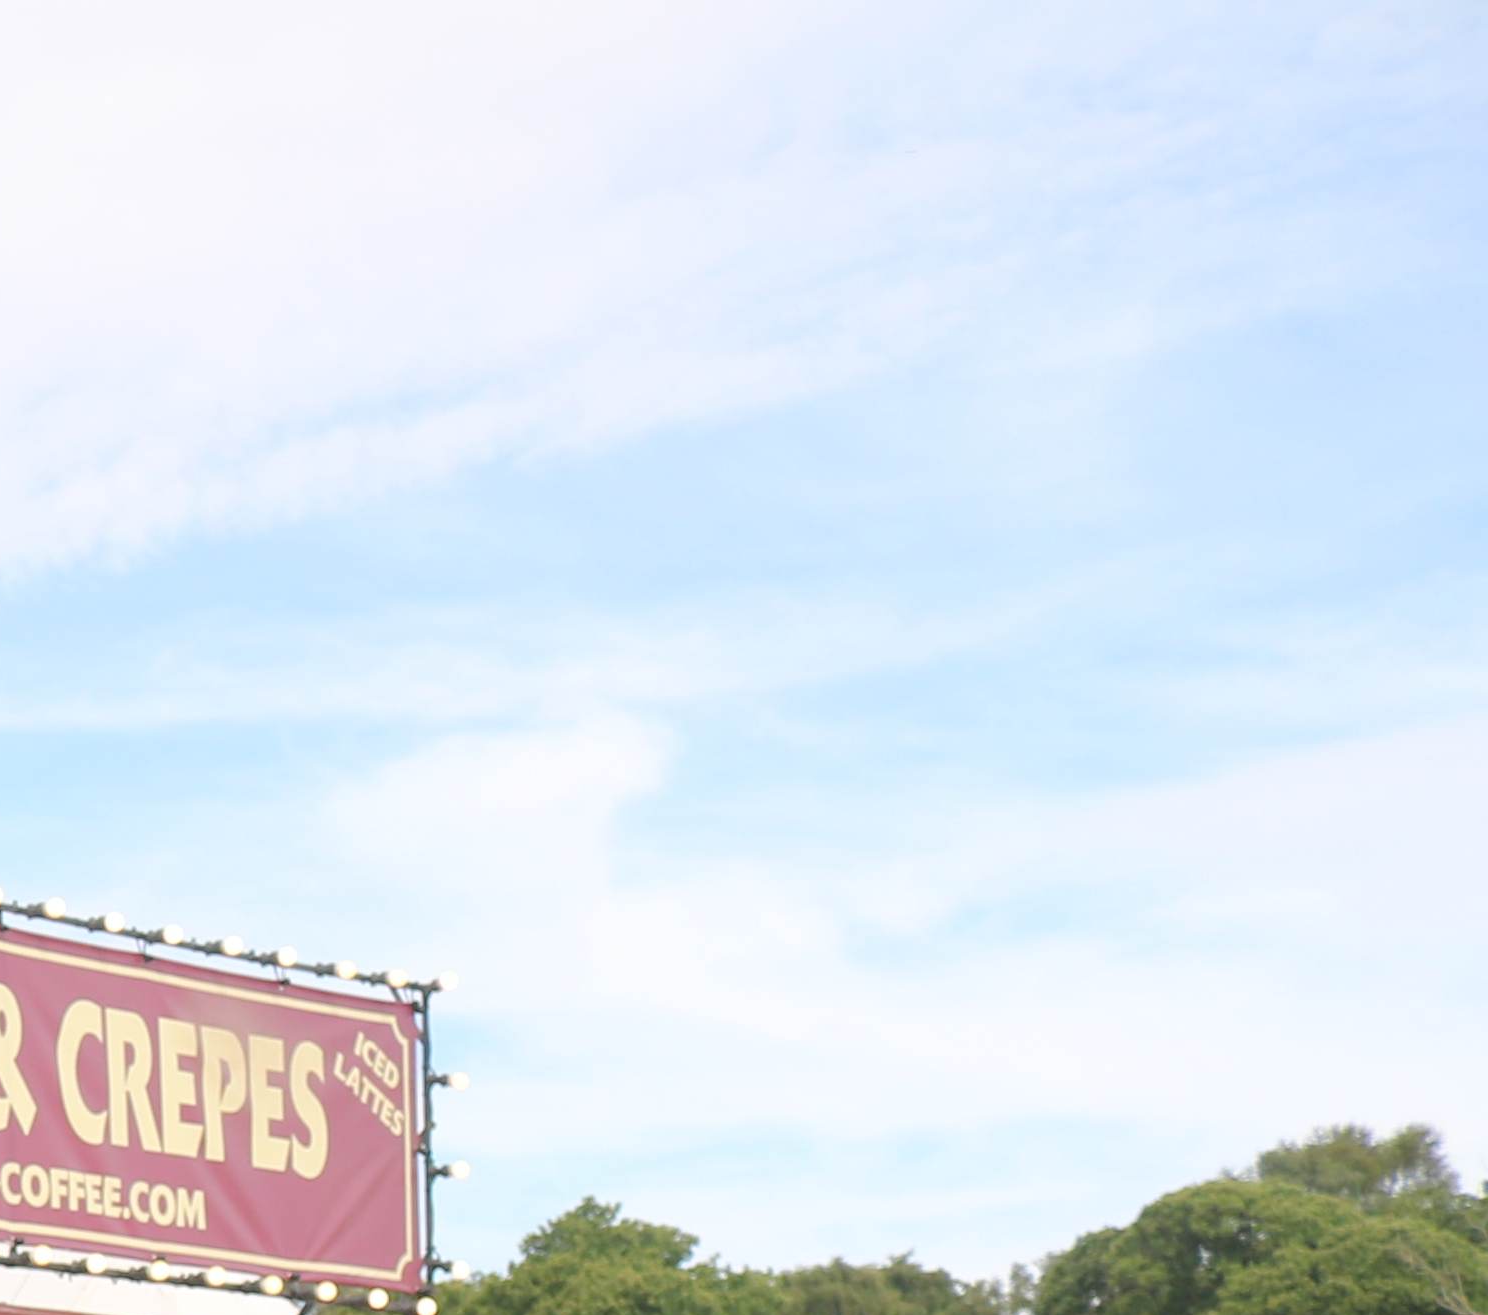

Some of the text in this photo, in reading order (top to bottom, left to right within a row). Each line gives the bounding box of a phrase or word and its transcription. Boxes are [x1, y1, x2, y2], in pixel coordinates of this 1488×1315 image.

[56, 999, 329, 1181] CREPES
[332, 1052, 406, 1138] LATTES
[352, 1031, 401, 1091] ICED
